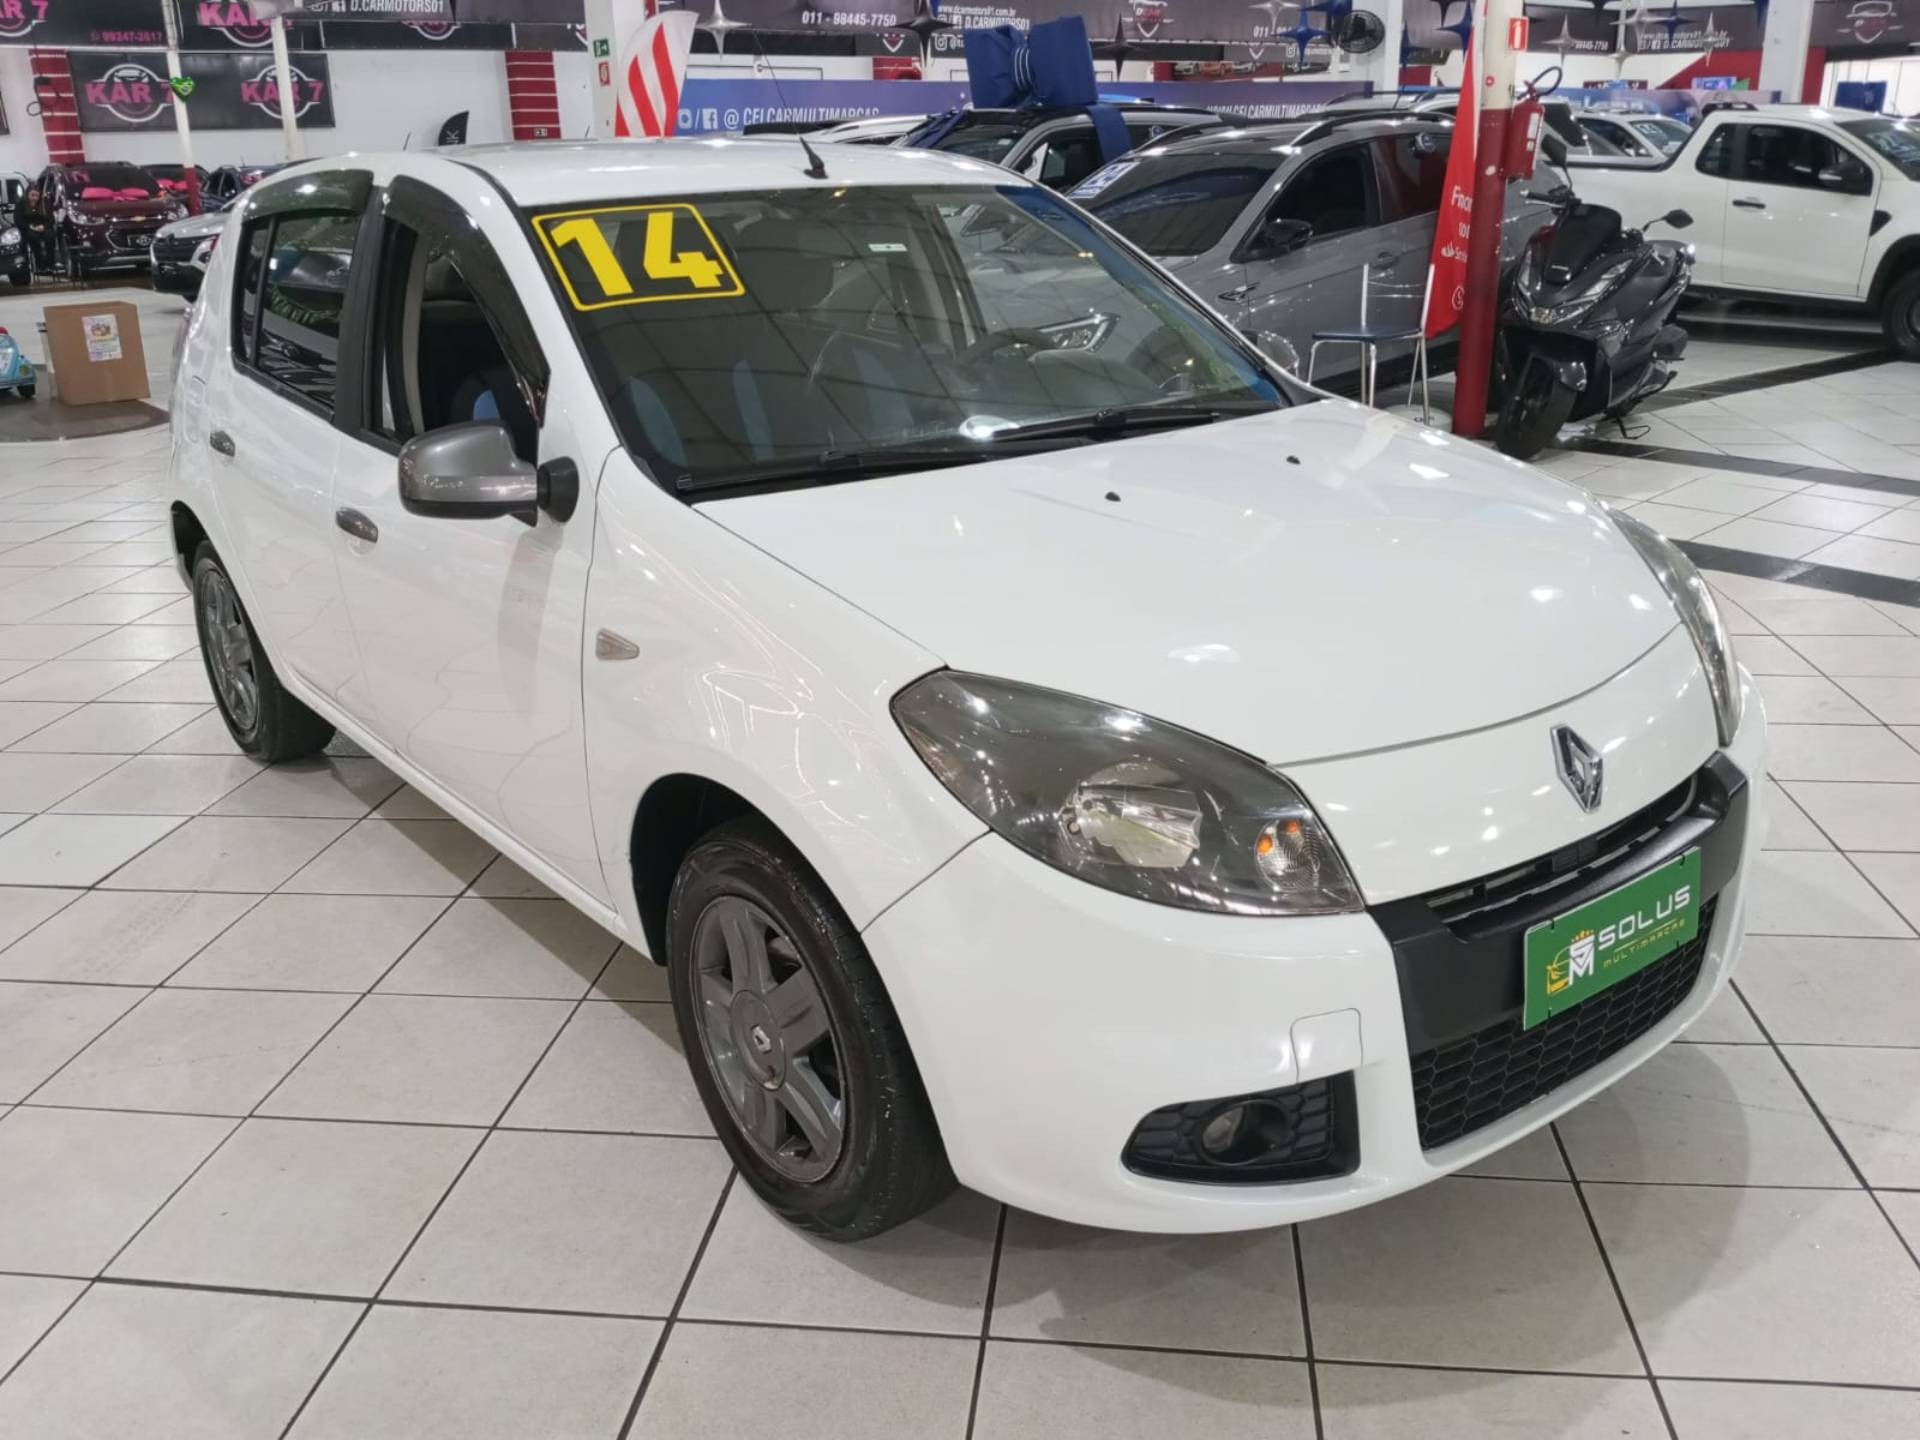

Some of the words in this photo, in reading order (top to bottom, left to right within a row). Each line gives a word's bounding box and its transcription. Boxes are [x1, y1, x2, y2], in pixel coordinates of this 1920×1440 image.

[802, 11, 822, 24] 011
[833, 12, 897, 26] 98445-7750
[85, 82, 153, 104] KAR
[308, 81, 325, 102] 7
[551, 211, 723, 296] 14
[1598, 885, 1690, 950] SOLUS
